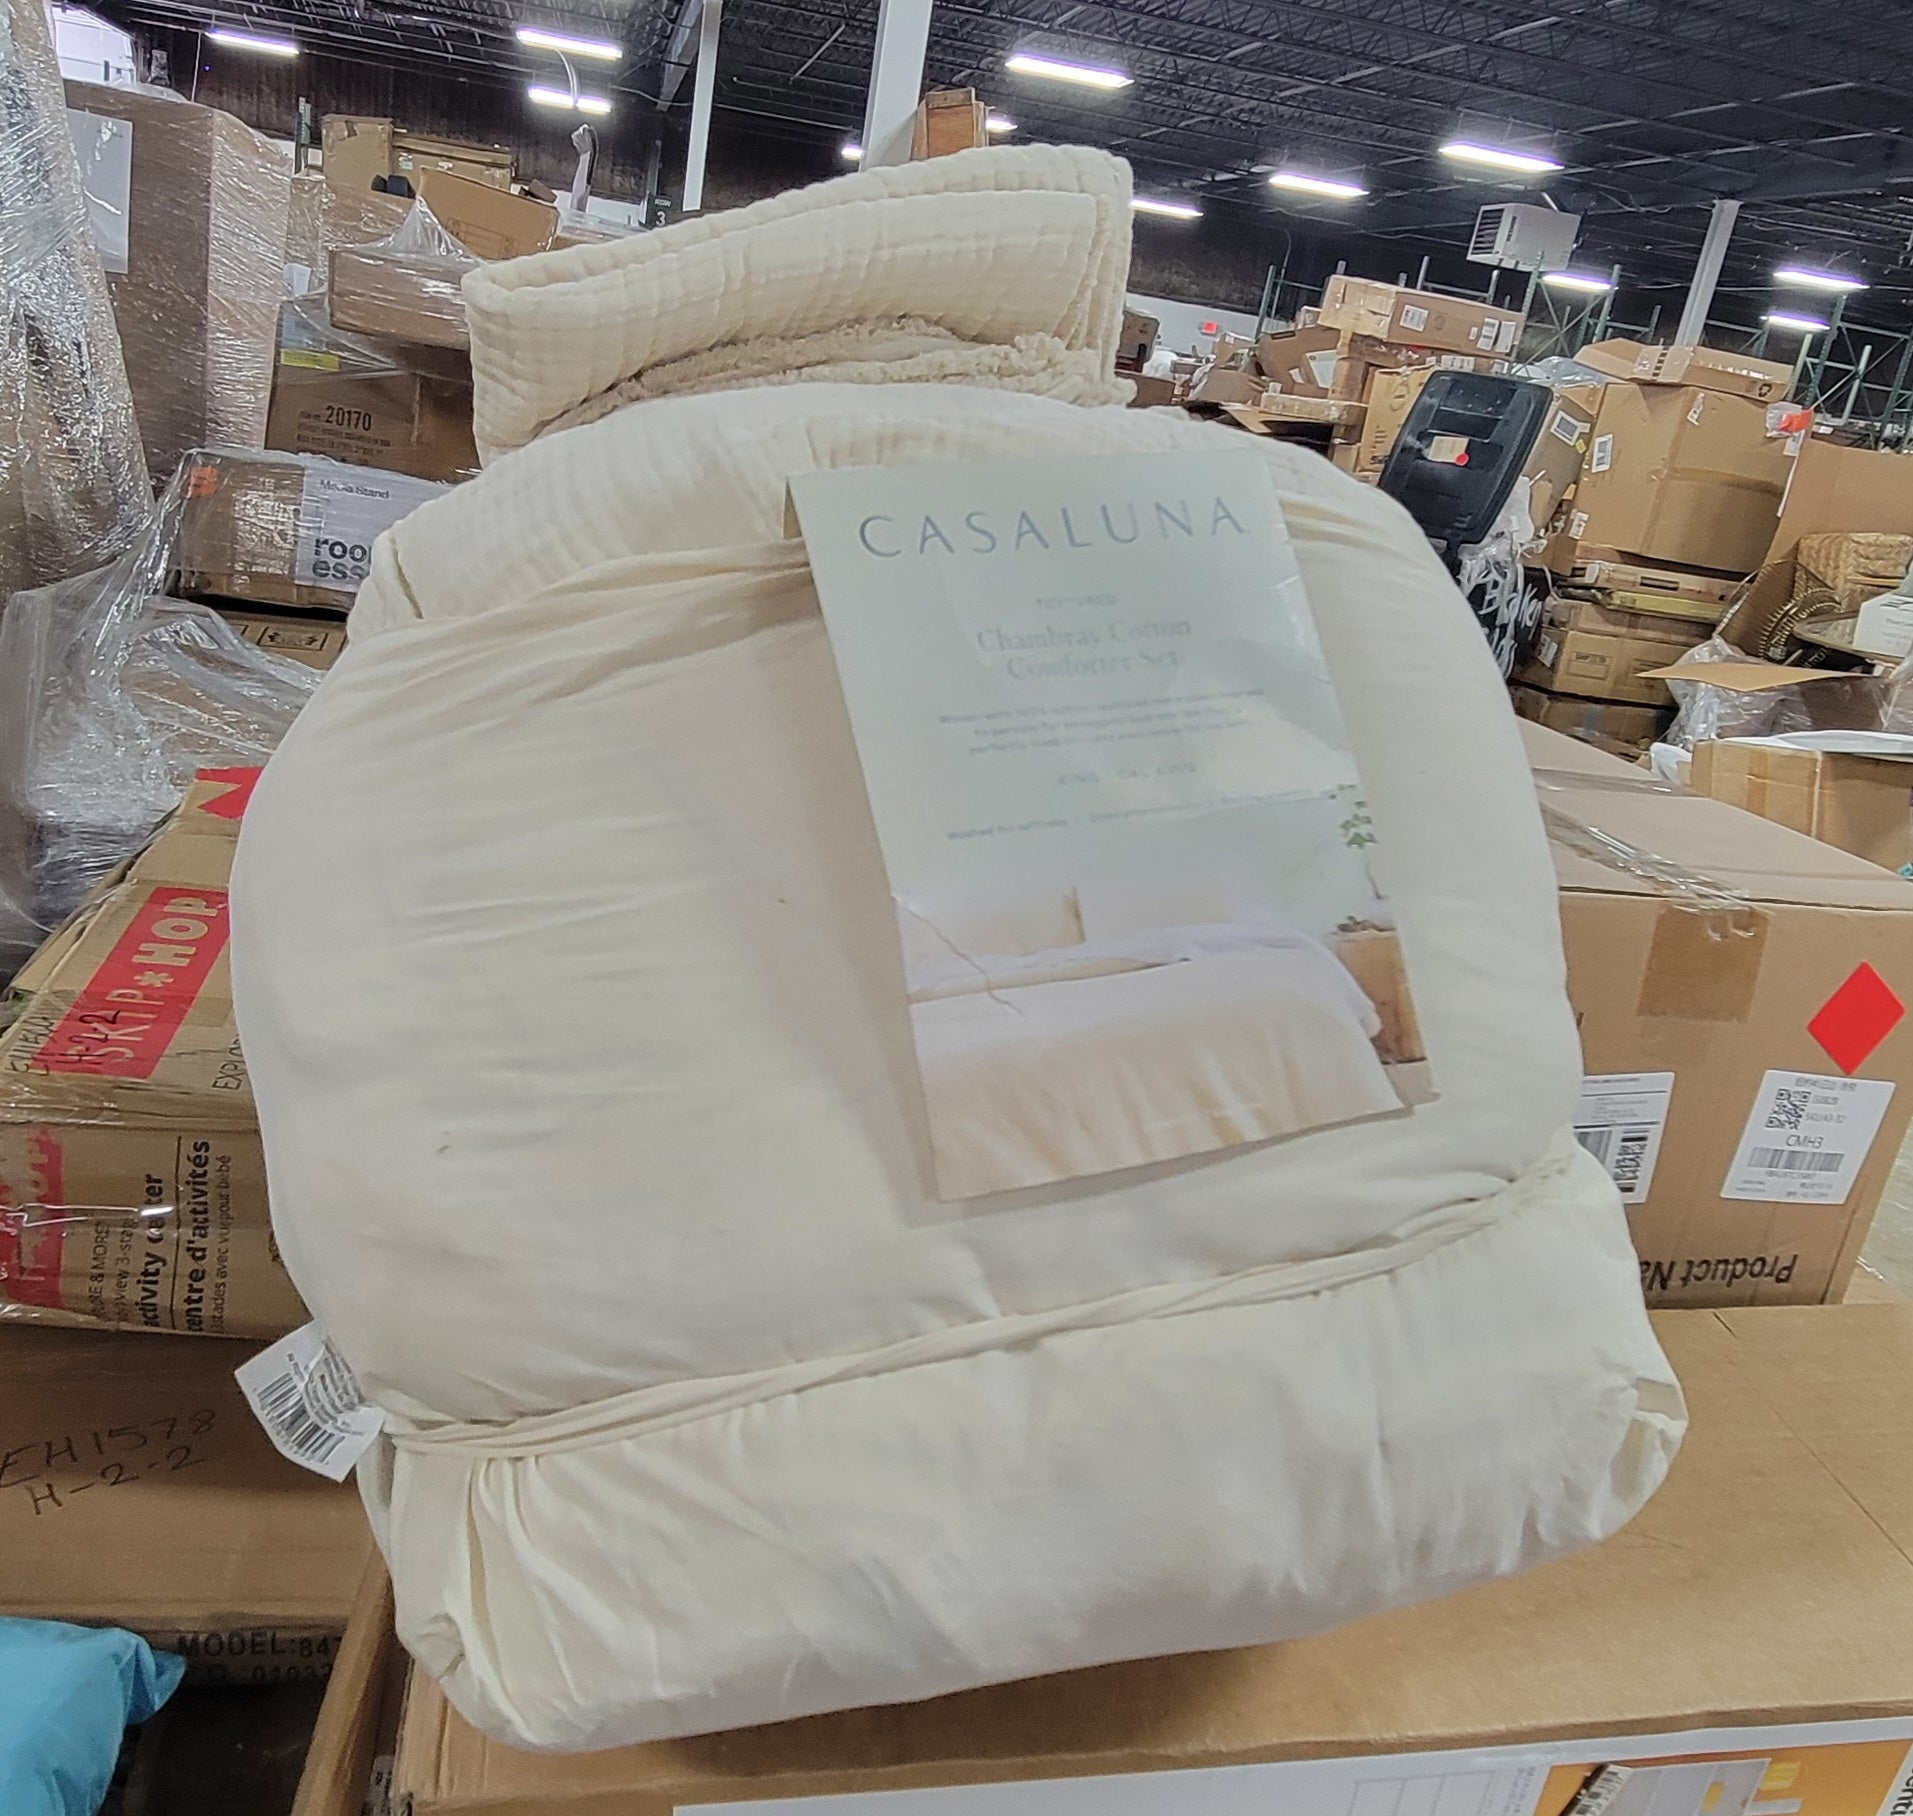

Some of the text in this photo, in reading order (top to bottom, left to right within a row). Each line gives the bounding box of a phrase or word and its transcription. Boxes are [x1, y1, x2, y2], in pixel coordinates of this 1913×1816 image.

[656, 211, 666, 226] 3
[325, 405, 372, 431] 20170
[858, 496, 1248, 558] CASALUNA
[314, 538, 372, 564] roo
[312, 560, 370, 579] ess
[1109, 619, 1192, 642] Cotton
[1138, 649, 1178, 668] Set
[66, 896, 219, 1064] SKIP HOP
[143, 1173, 165, 1244] ceter
[185, 1140, 211, 1263] d'activités
[1680, 1254, 1798, 1288] Product
[26, 1445, 207, 1515] H-2-2
